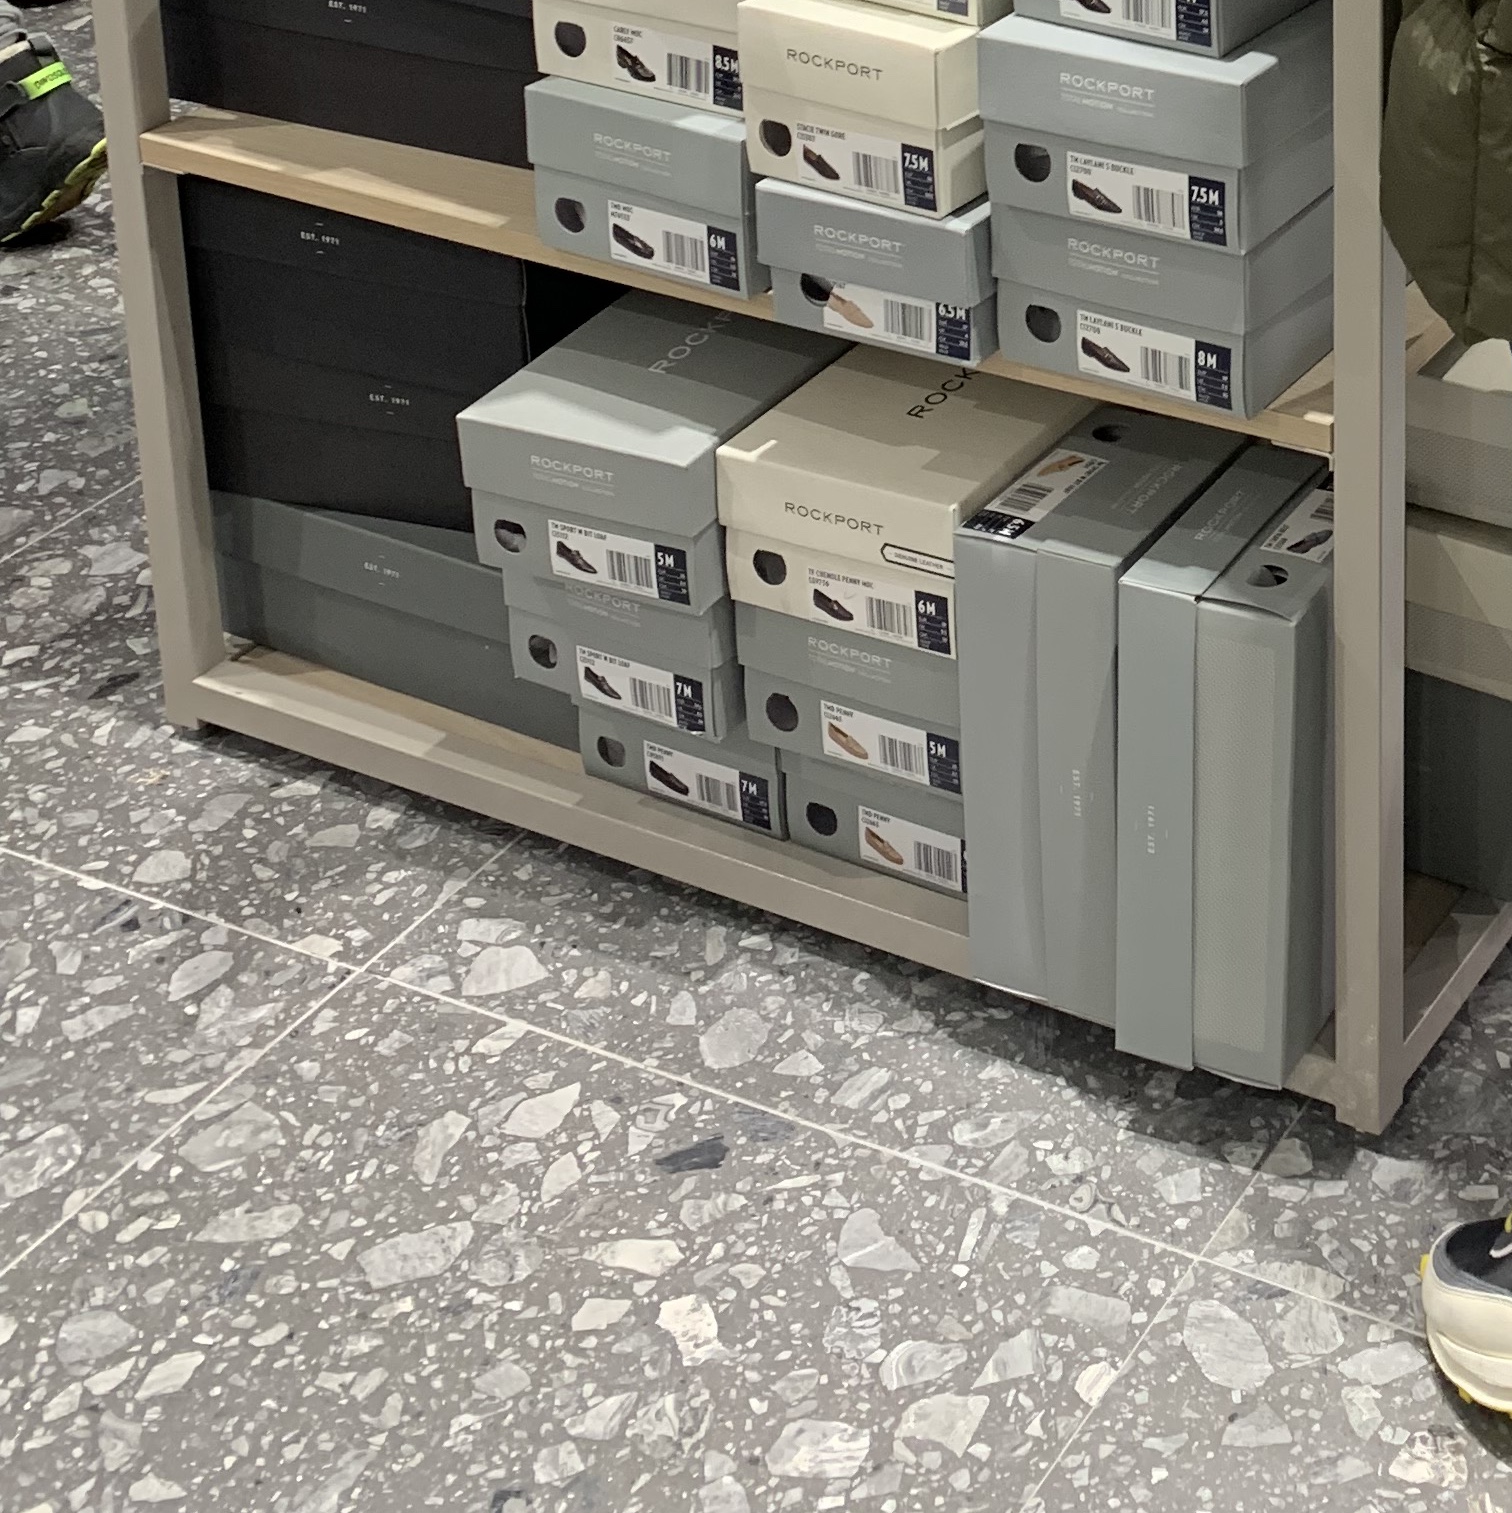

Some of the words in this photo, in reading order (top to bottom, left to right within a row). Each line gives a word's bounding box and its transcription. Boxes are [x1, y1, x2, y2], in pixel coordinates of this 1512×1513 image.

[328, 0, 346, 10] EST.
[786, 48, 883, 81] ROCKPORT
[1059, 72, 1155, 101] ROCKPORT
[593, 132, 672, 162] ROCKPORT
[300, 231, 319, 242] EST.
[709, 234, 726, 250] 6M
[813, 224, 903, 253] ROCKPORT
[1067, 238, 1160, 269] ROCKPORT
[648, 310, 732, 374] ROCKP
[1197, 350, 1217, 370] 8M
[906, 367, 980, 419] ROCK
[530, 454, 614, 483] ROCKPORT
[784, 501, 884, 536] ROCKPORT
[657, 552, 674, 568] 5M
[917, 599, 935, 616] 6M
[807, 636, 893, 669] ROCKPORT
[676, 682, 692, 698] 7M
[929, 740, 946, 758] 5M
[741, 780, 757, 796] 7M
